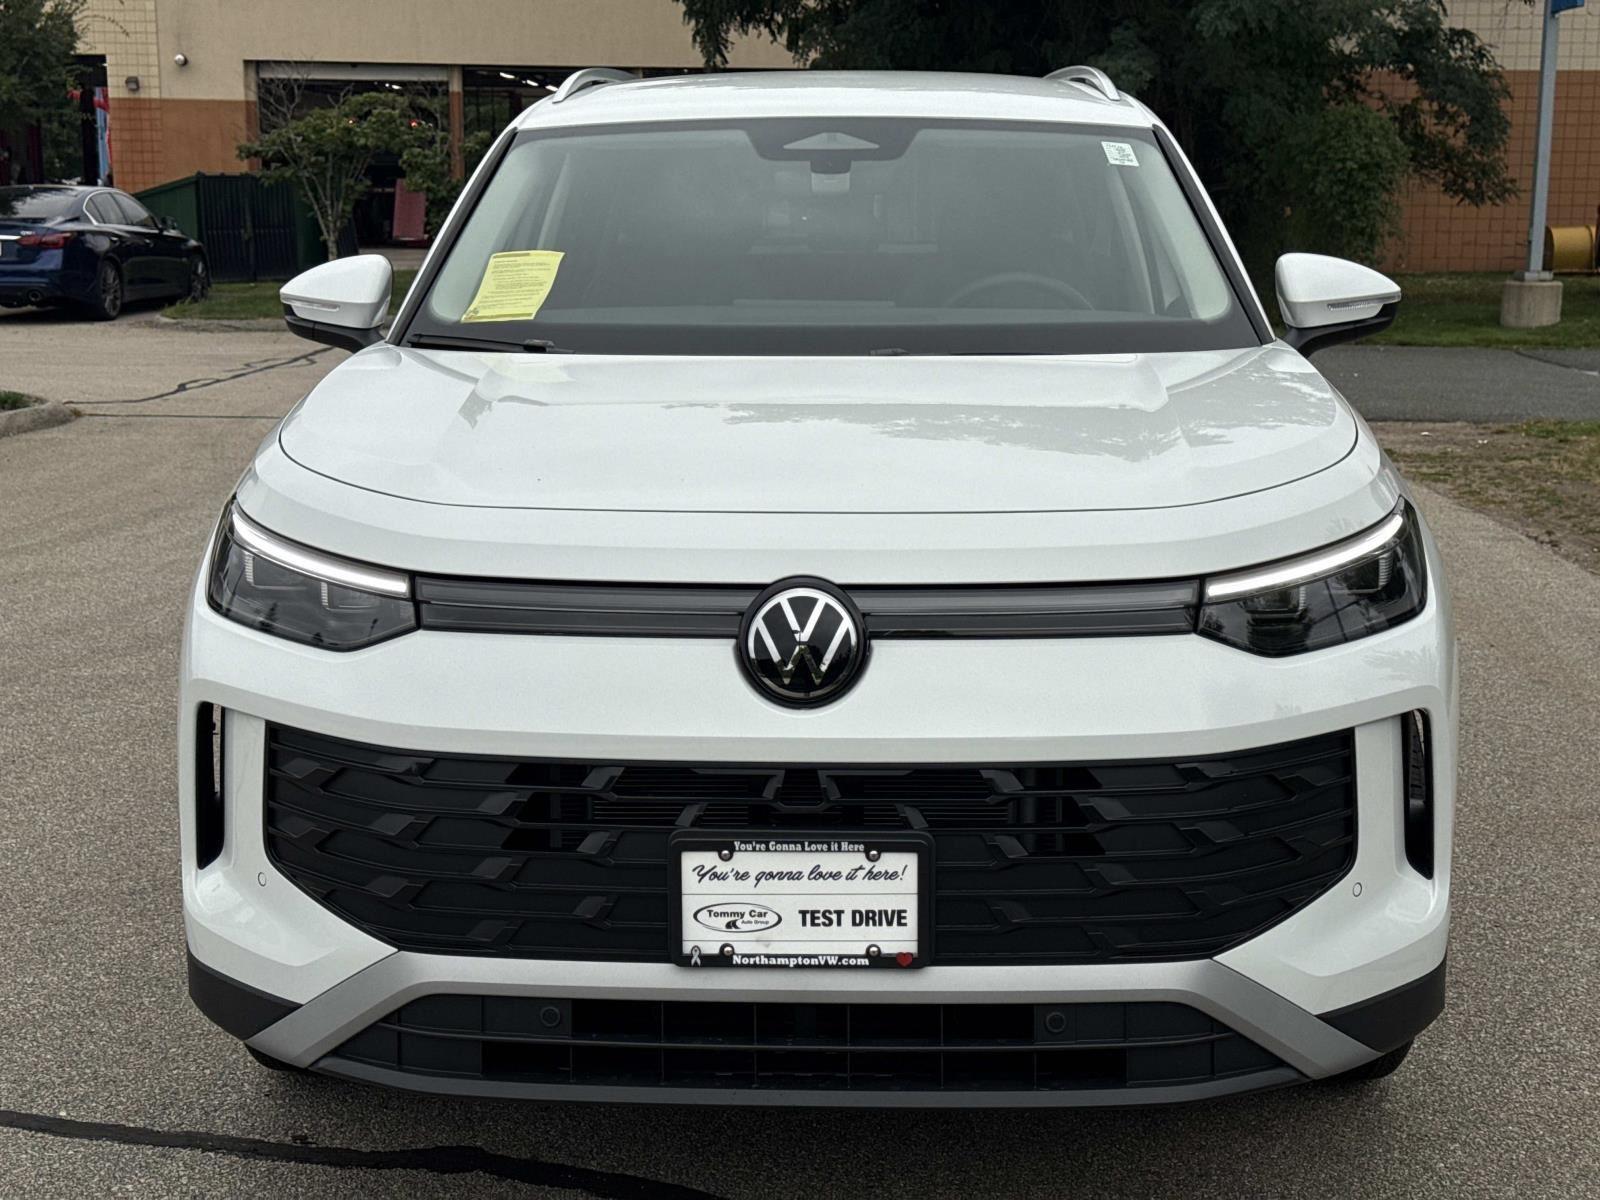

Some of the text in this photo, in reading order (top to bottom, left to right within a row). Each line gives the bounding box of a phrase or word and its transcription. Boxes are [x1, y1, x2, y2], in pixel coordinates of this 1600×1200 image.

[752, 592, 853, 690] VW
[734, 841, 865, 852] You're Gonna Love it Here
[692, 864, 908, 888] You're gonna love it here!
[707, 909, 769, 920] Tommy Car
[798, 909, 908, 928] TEST DRIVE
[732, 954, 870, 967] NorthamptonVW.com
